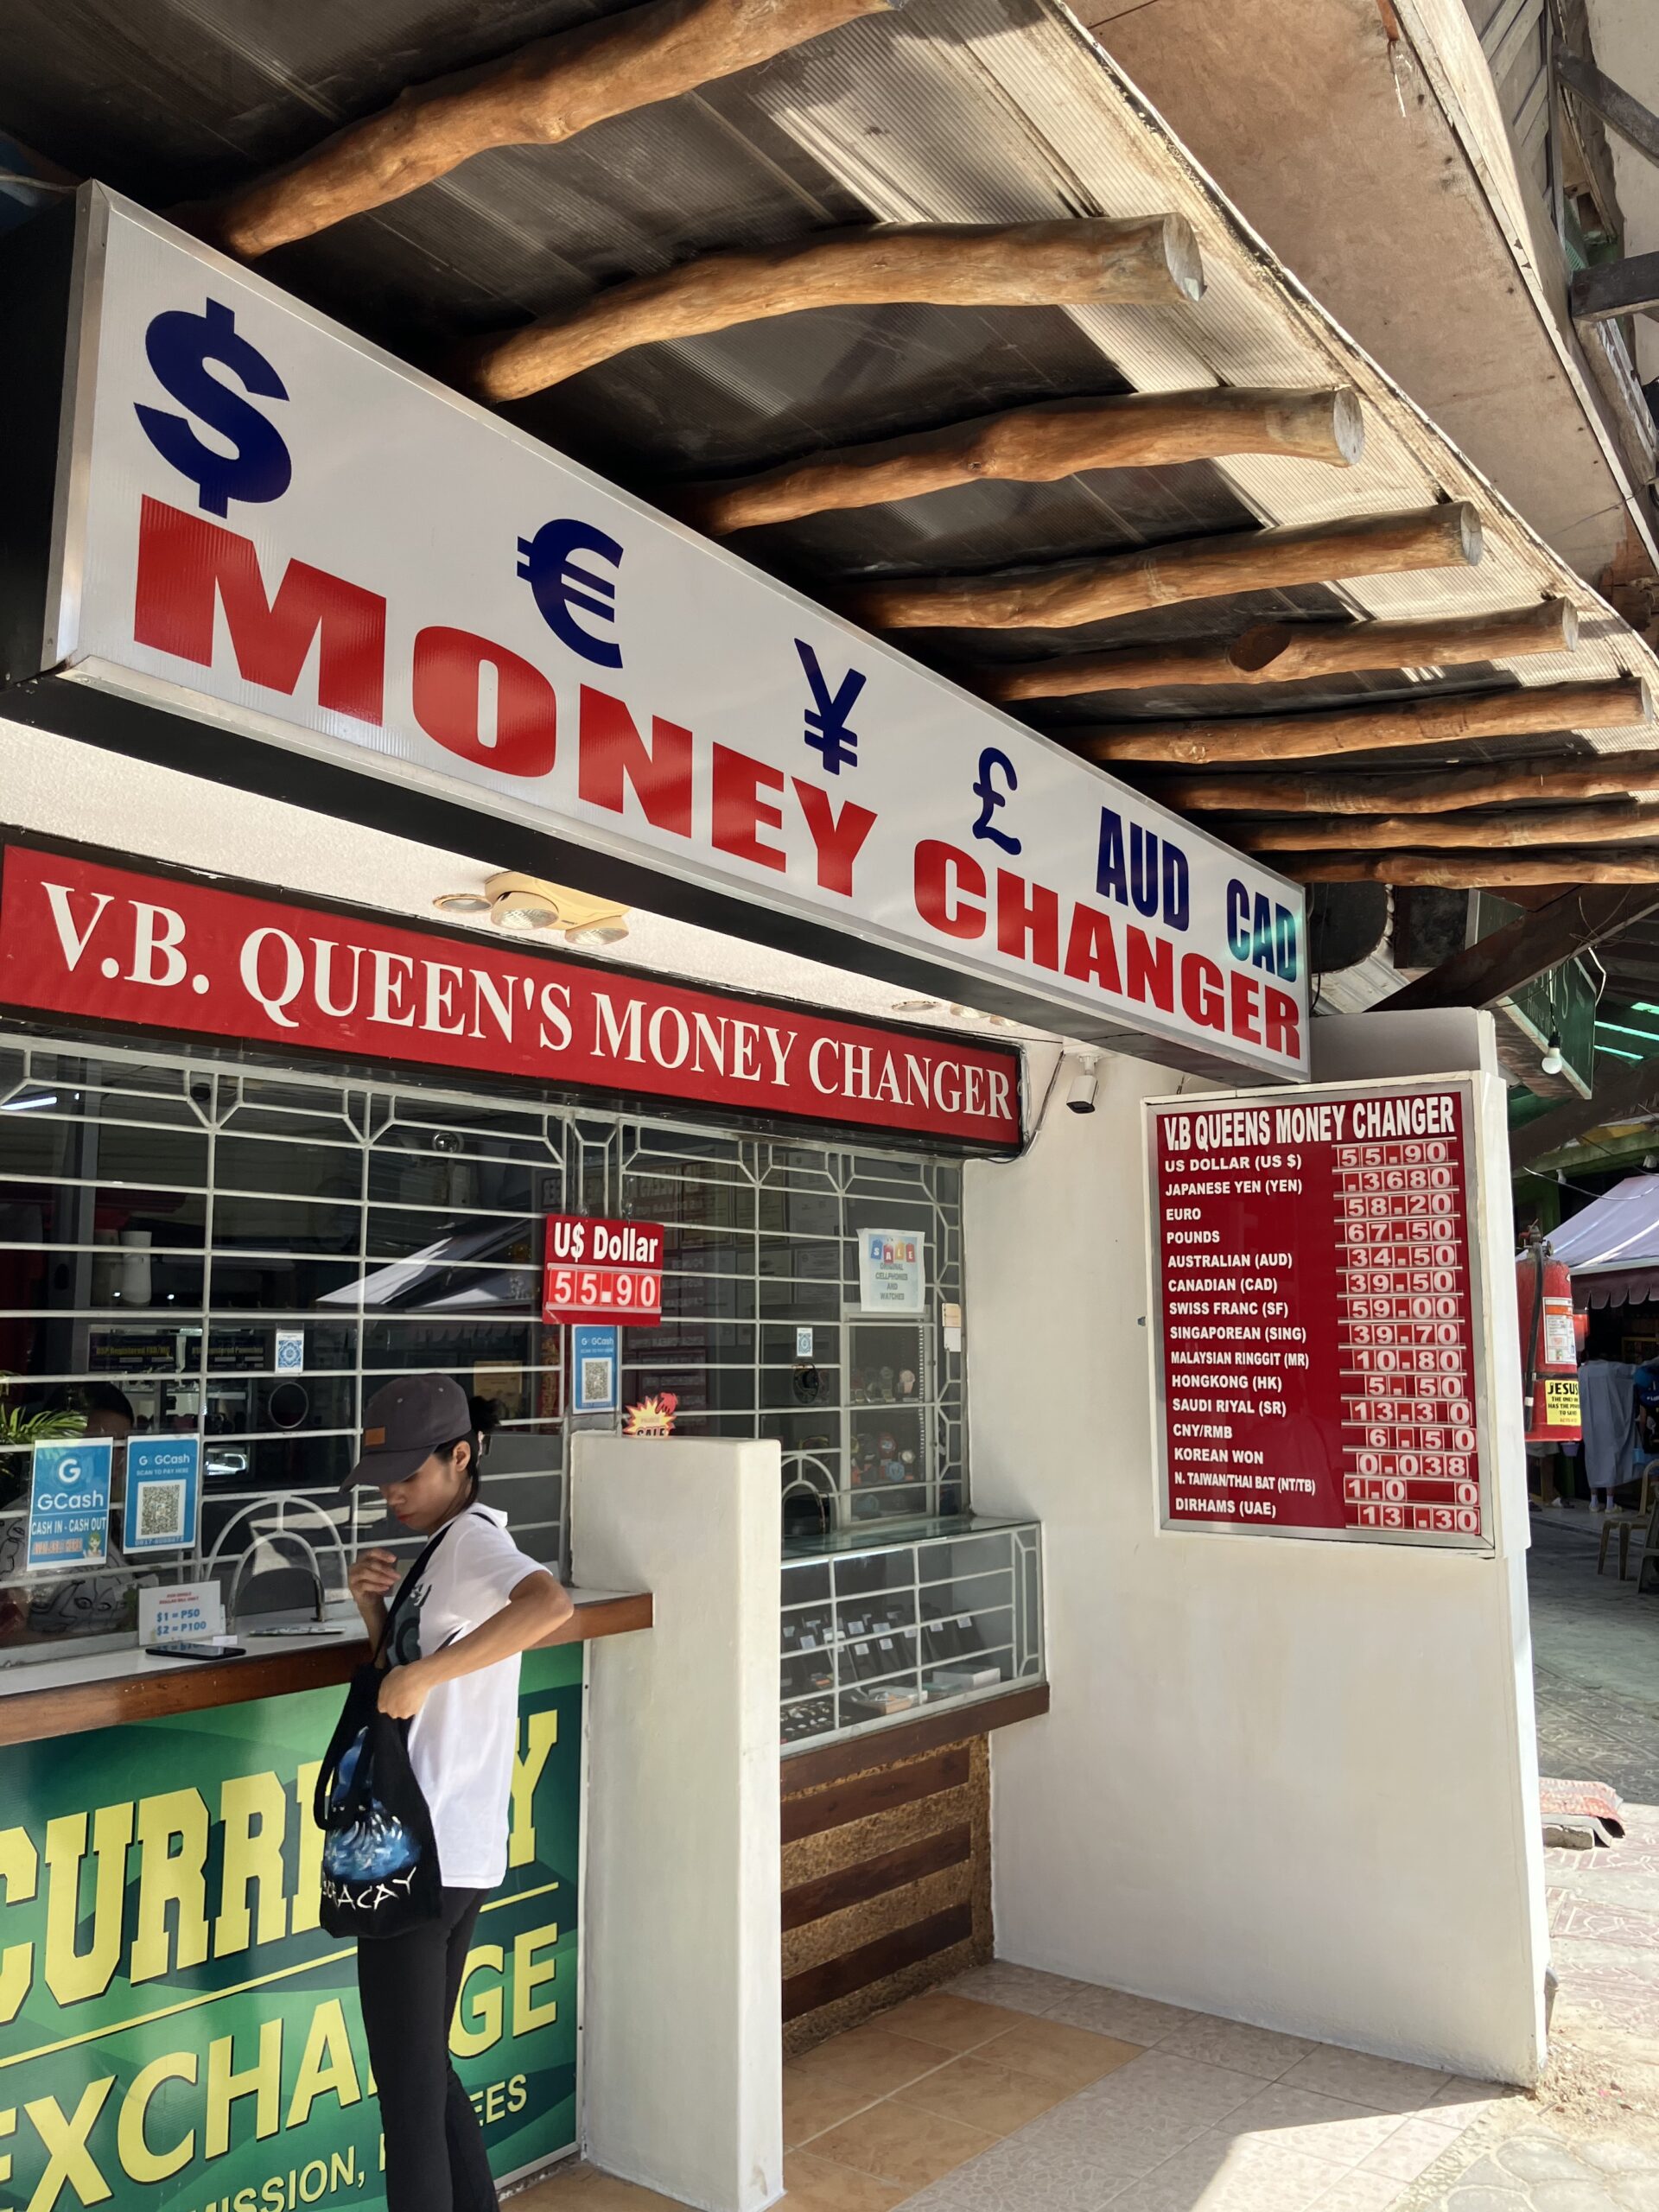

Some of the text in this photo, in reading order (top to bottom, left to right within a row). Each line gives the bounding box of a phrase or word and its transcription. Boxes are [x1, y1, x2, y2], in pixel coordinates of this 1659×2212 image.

[134, 297, 1297, 983] $ € ¥ £ AUD CAD
[134, 494, 1300, 1059] MONEY CHANGER
[40, 880, 1013, 1120] V.B. QUEEN'S MONEY CHANGER
[1164, 1096, 1454, 1152] V.B QUEENS MONEY CHANGER
[1166, 1142, 1446, 1172] US DOLLAR (US $) 55.90
[1166, 1166, 1449, 1196] JAPANESE YEN (YEN) .3680
[1166, 1193, 1451, 1220] EURO 58.20
[554, 1222, 658, 1262] U$ Dollar
[1167, 1219, 1452, 1243] POUNDS 67.50
[1168, 1245, 1455, 1269] AUSTRALIAN (AUD) 34.50
[555, 1271, 656, 1307] 55.90
[1168, 1271, 1453, 1294] CANADIAN (CAD) 39.50
[1170, 1299, 1455, 1319] SWISS FRANC (SF) 59.00
[1170, 1325, 1457, 1344] SINGAPOREAN (SING) 39.70
[1171, 1350, 1459, 1370] MALAYSIAN RINGGIT (MR) 10.80
[1173, 1375, 1248, 1389] HONGKONG
[1253, 1376, 1281, 1392] (HK)
[1173, 1398, 1211, 1412] SAUDI
[1217, 1400, 1255, 1414] RIYAL
[1259, 1401, 1286, 1417] (SR)
[1173, 1424, 1232, 1439] CNY/RMB
[155, 1453, 190, 1465] GCash
[1174, 1447, 1465, 1476] KOREAN WON 0.038
[1175, 1471, 1185, 1484] N.
[1187, 1472, 1252, 1488] TAIWAN/THAI
[1255, 1476, 1275, 1490] BAT
[1278, 1478, 1315, 1496] (NT/TB)
[37, 1490, 104, 1510] GCash
[1176, 1497, 1235, 1513] DIRHAMS
[1240, 1501, 1276, 1518] (UAE)
[32, 1522, 52, 1535] CASH
[54, 1520, 63, 1534] IN
[69, 1519, 89, 1532] CASH
[91, 1516, 107, 1530] OUT
[181, 1608, 200, 1619] P50
[181, 1621, 207, 1631] P100
